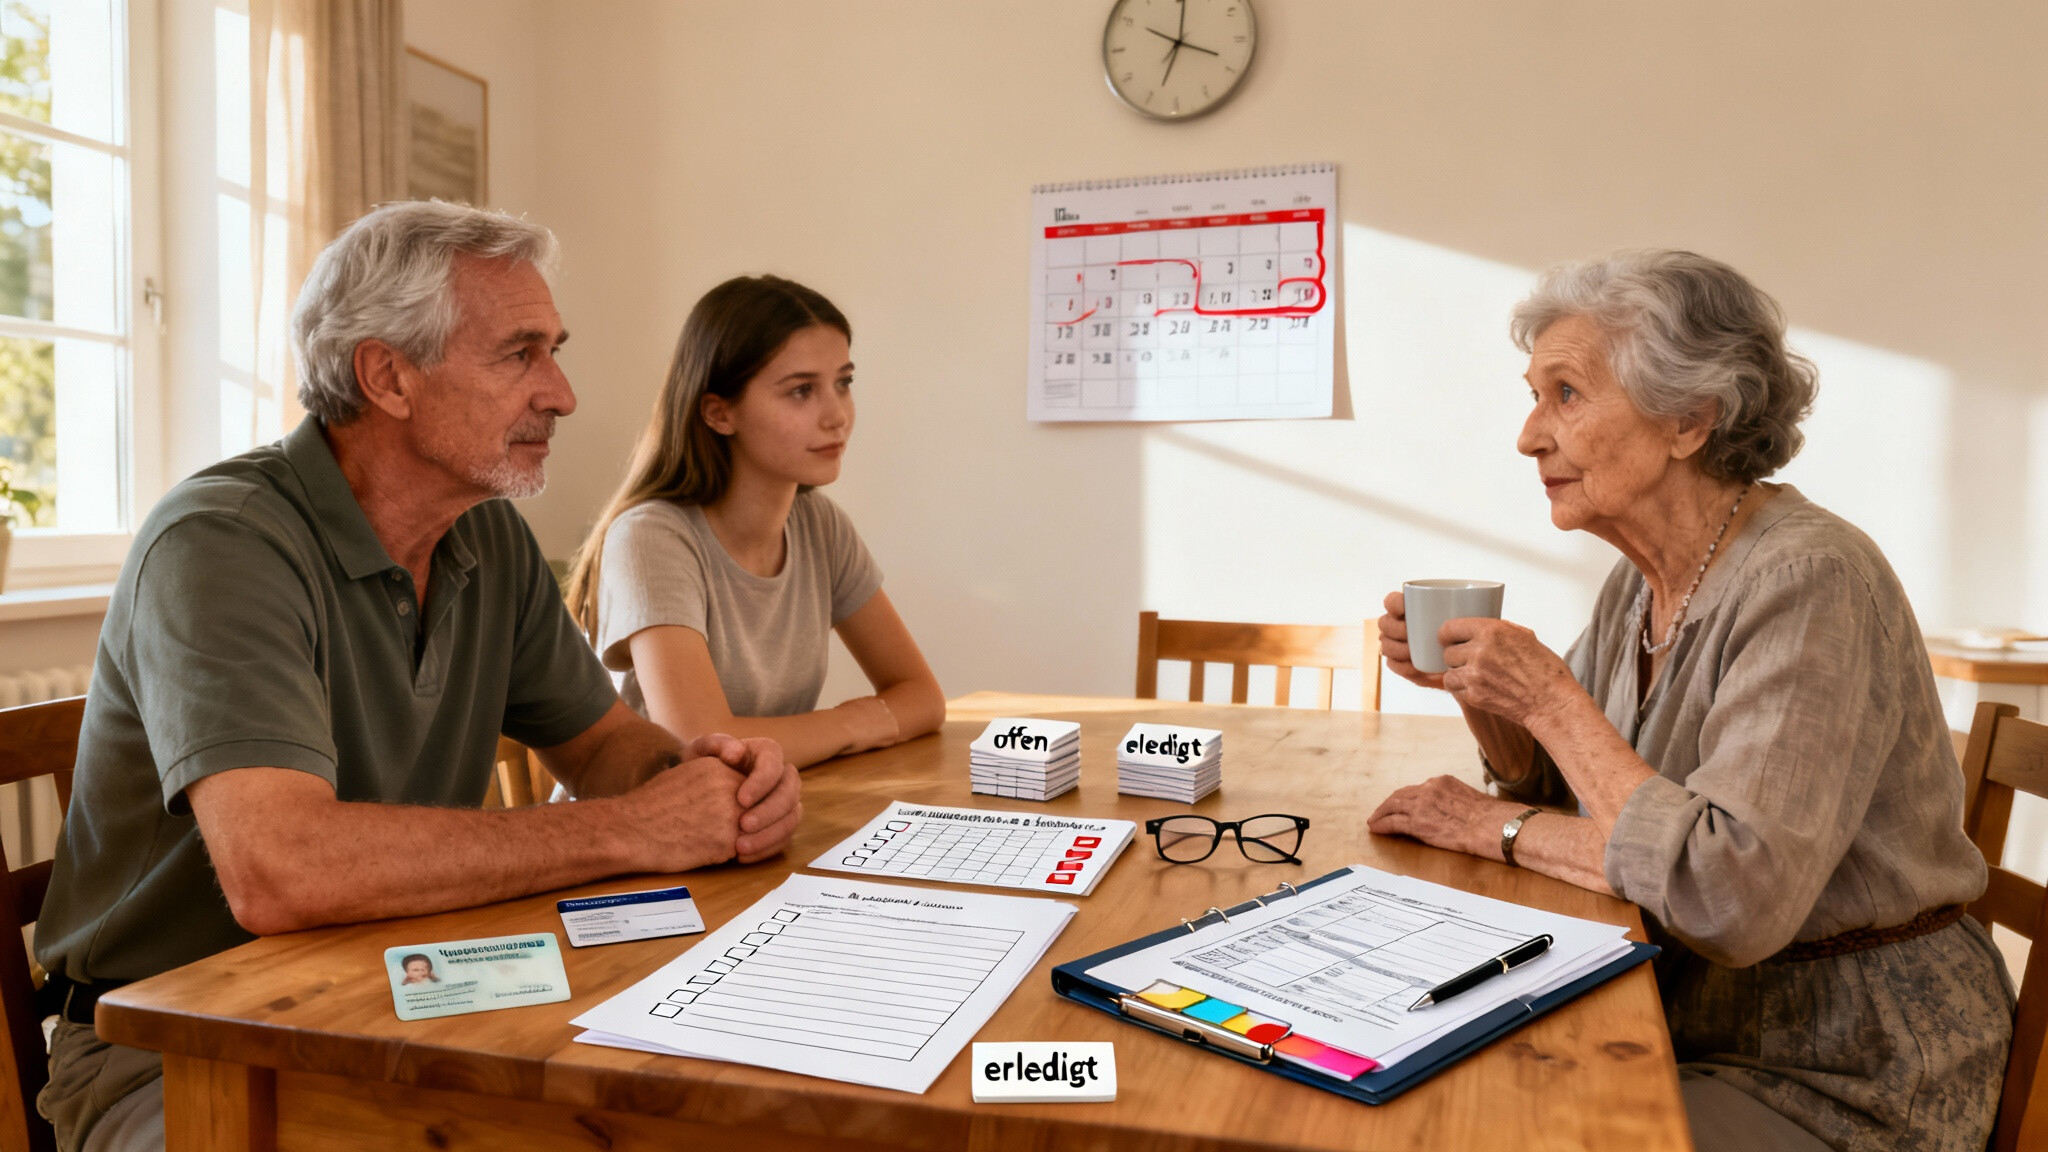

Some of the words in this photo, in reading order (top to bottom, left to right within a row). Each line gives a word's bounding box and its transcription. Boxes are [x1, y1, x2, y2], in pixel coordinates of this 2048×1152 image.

[994, 726, 1048, 751] offen
[1126, 733, 1202, 764] eledigt
[984, 1051, 1098, 1088] erledigt
